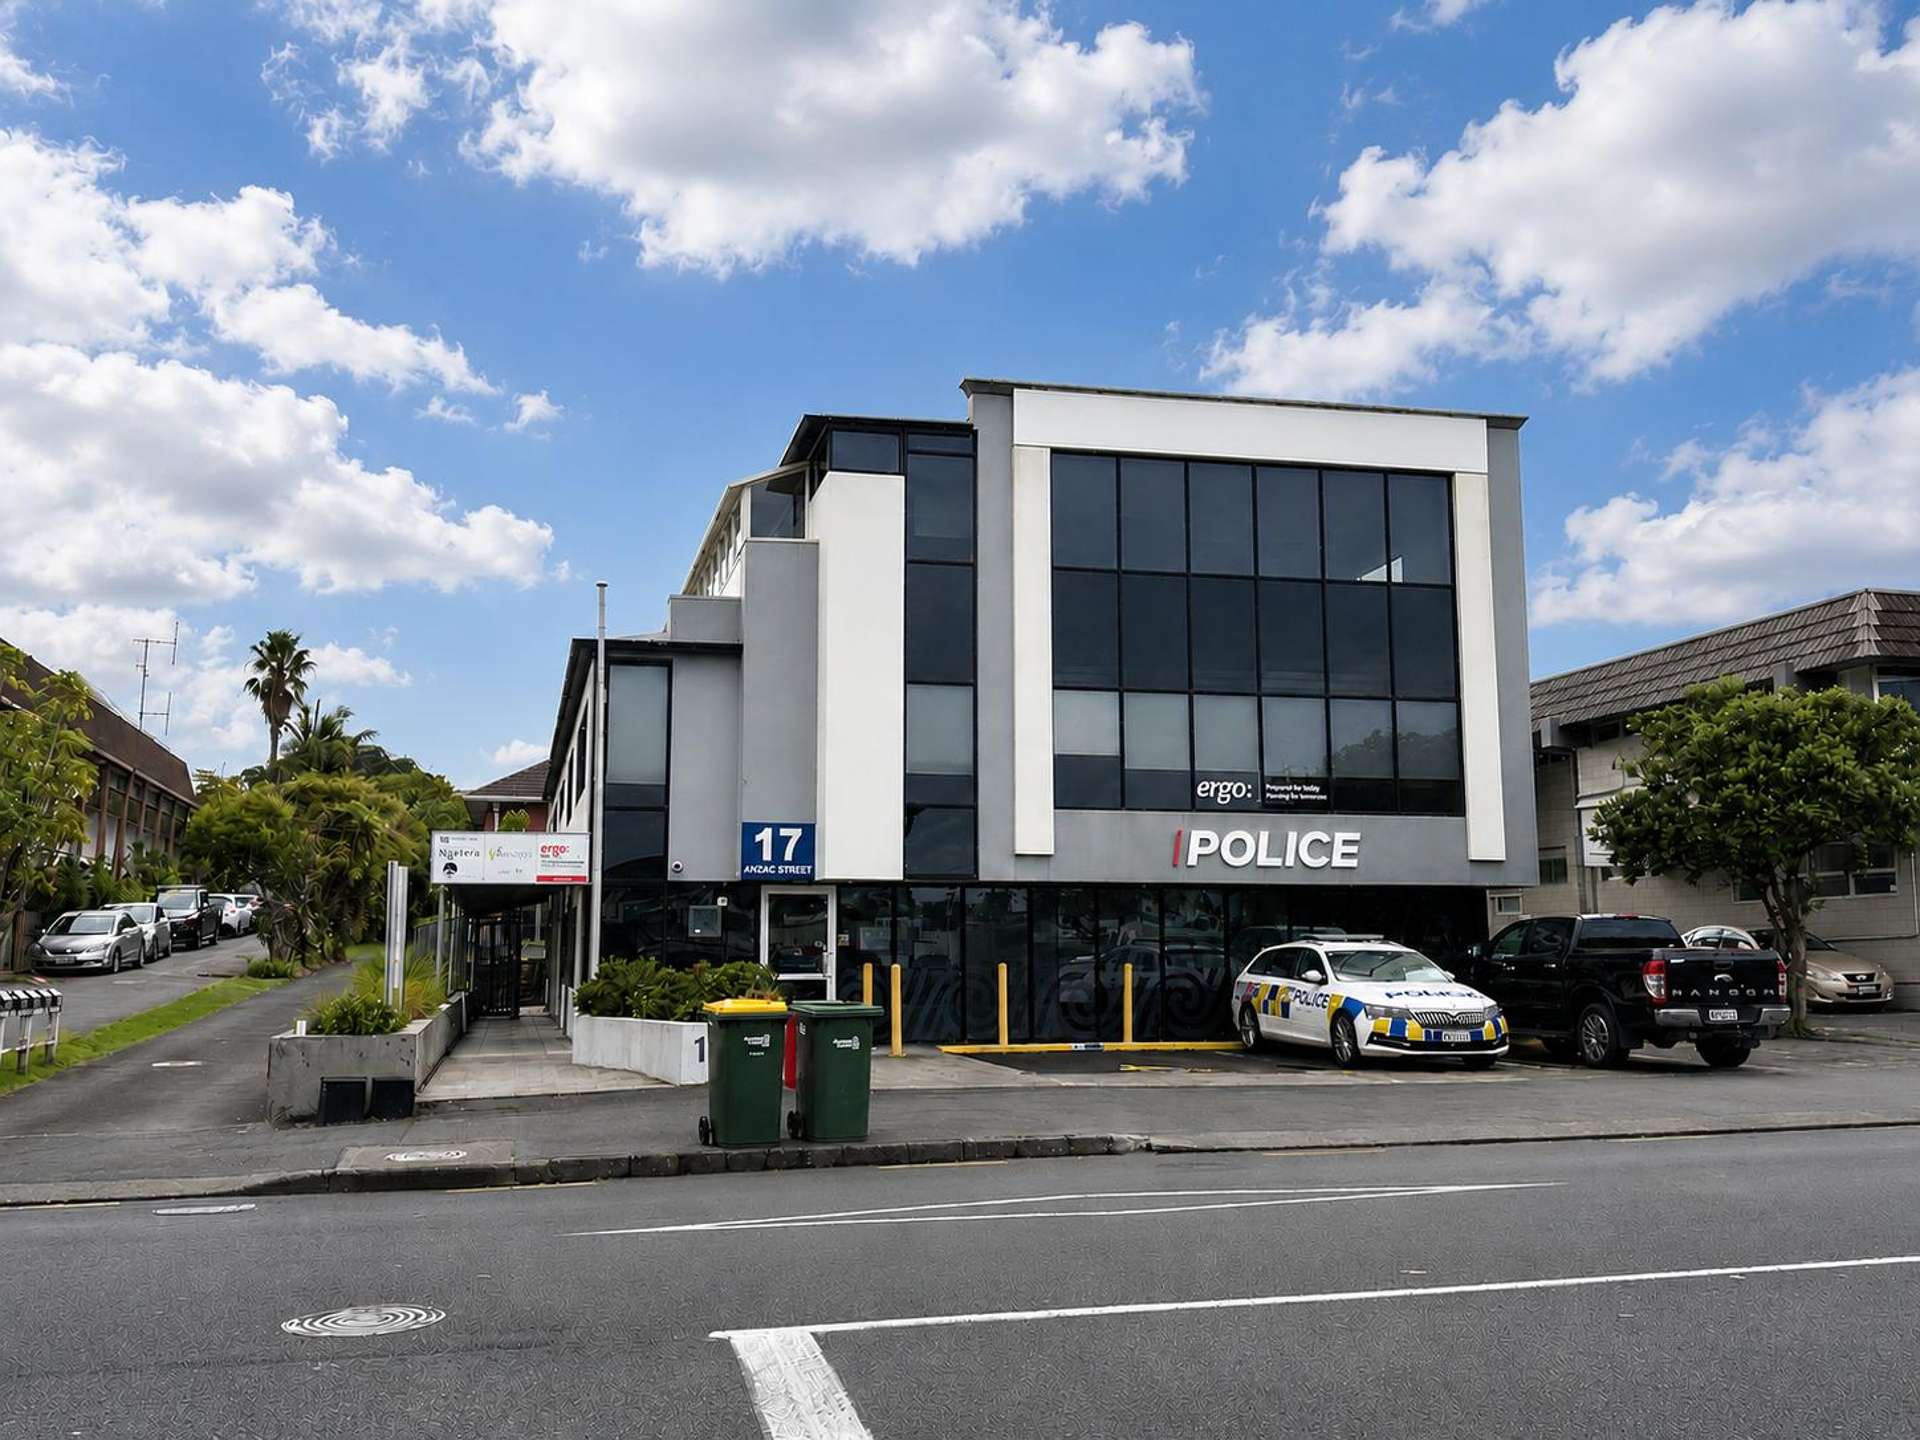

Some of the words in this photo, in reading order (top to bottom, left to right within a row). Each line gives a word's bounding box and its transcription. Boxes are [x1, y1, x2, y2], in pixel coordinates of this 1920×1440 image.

[1196, 780, 1252, 804] ergo:
[754, 827, 802, 861] 17
[1186, 830, 1361, 868] POLICE
[743, 865, 776, 874] ANZAC
[777, 865, 813, 875] STREET
